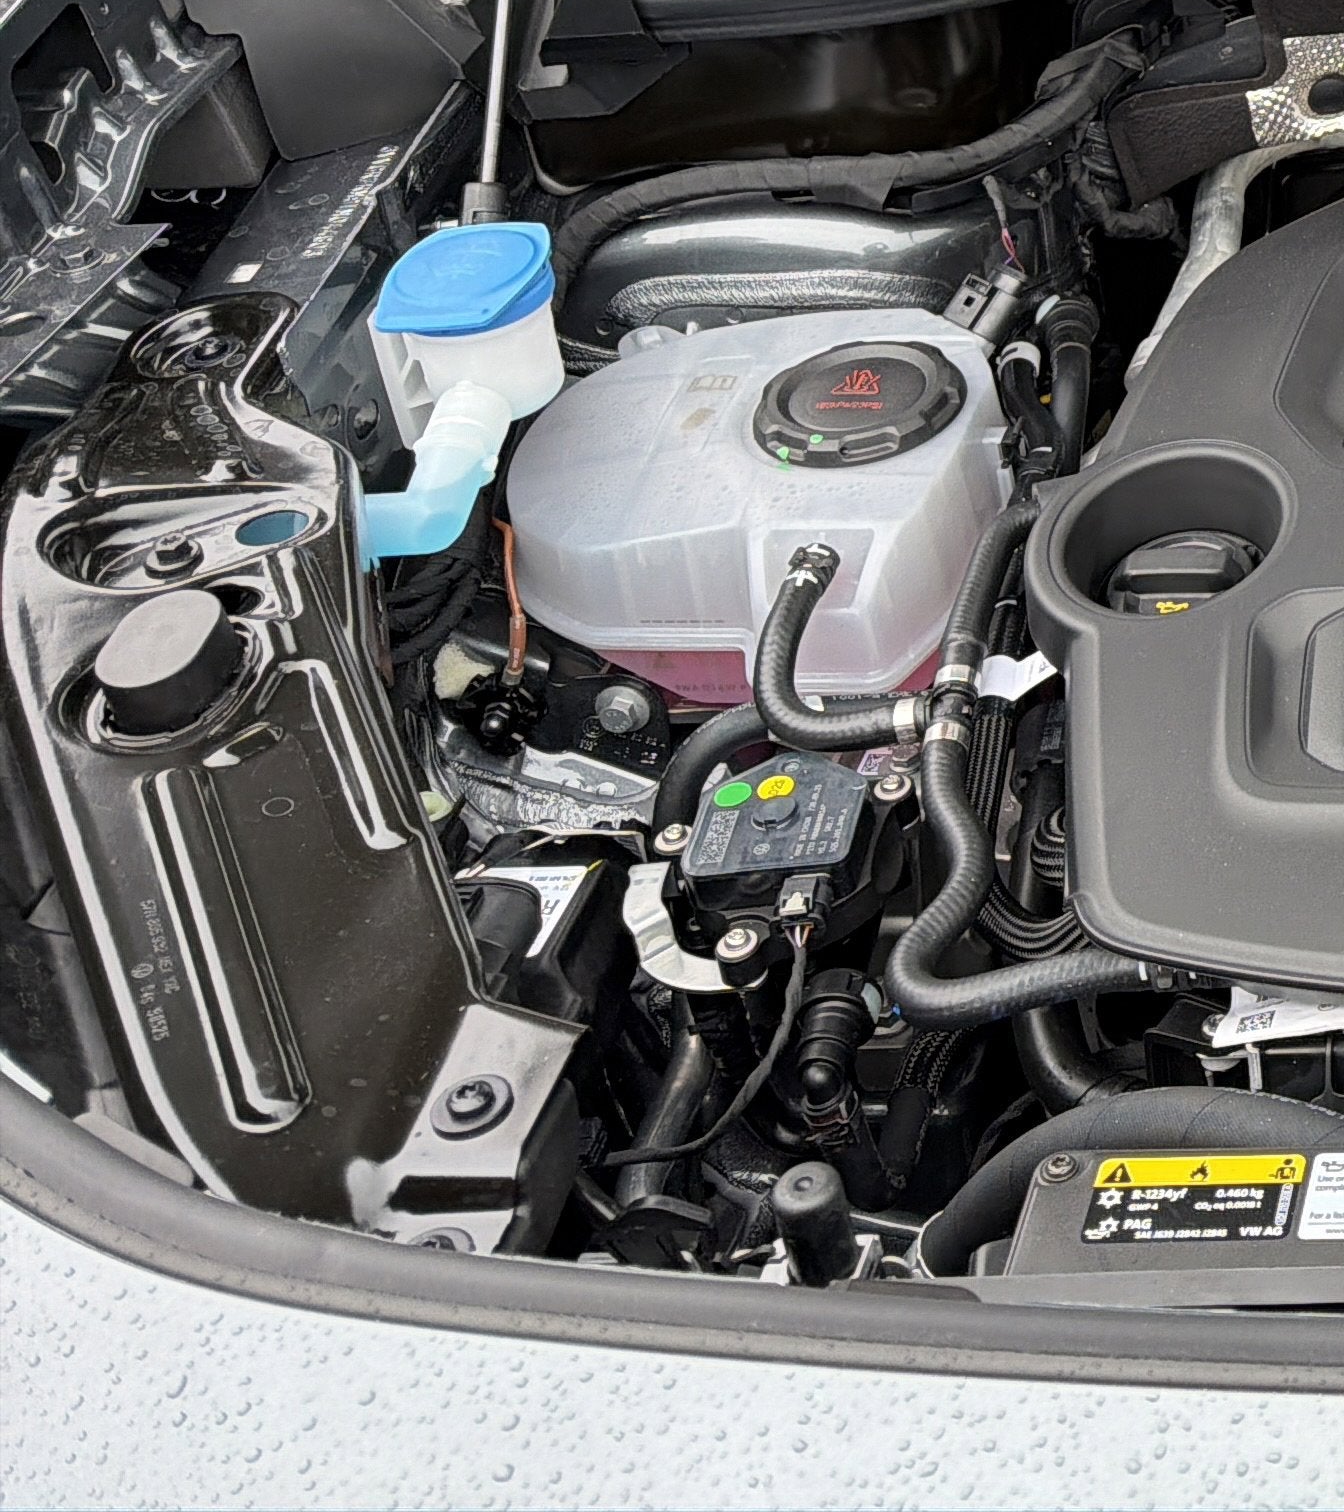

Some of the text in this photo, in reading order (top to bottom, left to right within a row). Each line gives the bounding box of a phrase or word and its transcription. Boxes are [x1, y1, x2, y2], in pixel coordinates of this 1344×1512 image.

[1131, 1188, 1265, 1202] R-1234yf 0.460 kg
[1309, 1211, 1324, 1219] For
[1123, 1219, 1153, 1230] PAG
[1239, 1226, 1261, 1237] VW
[1262, 1226, 1284, 1237] AG
